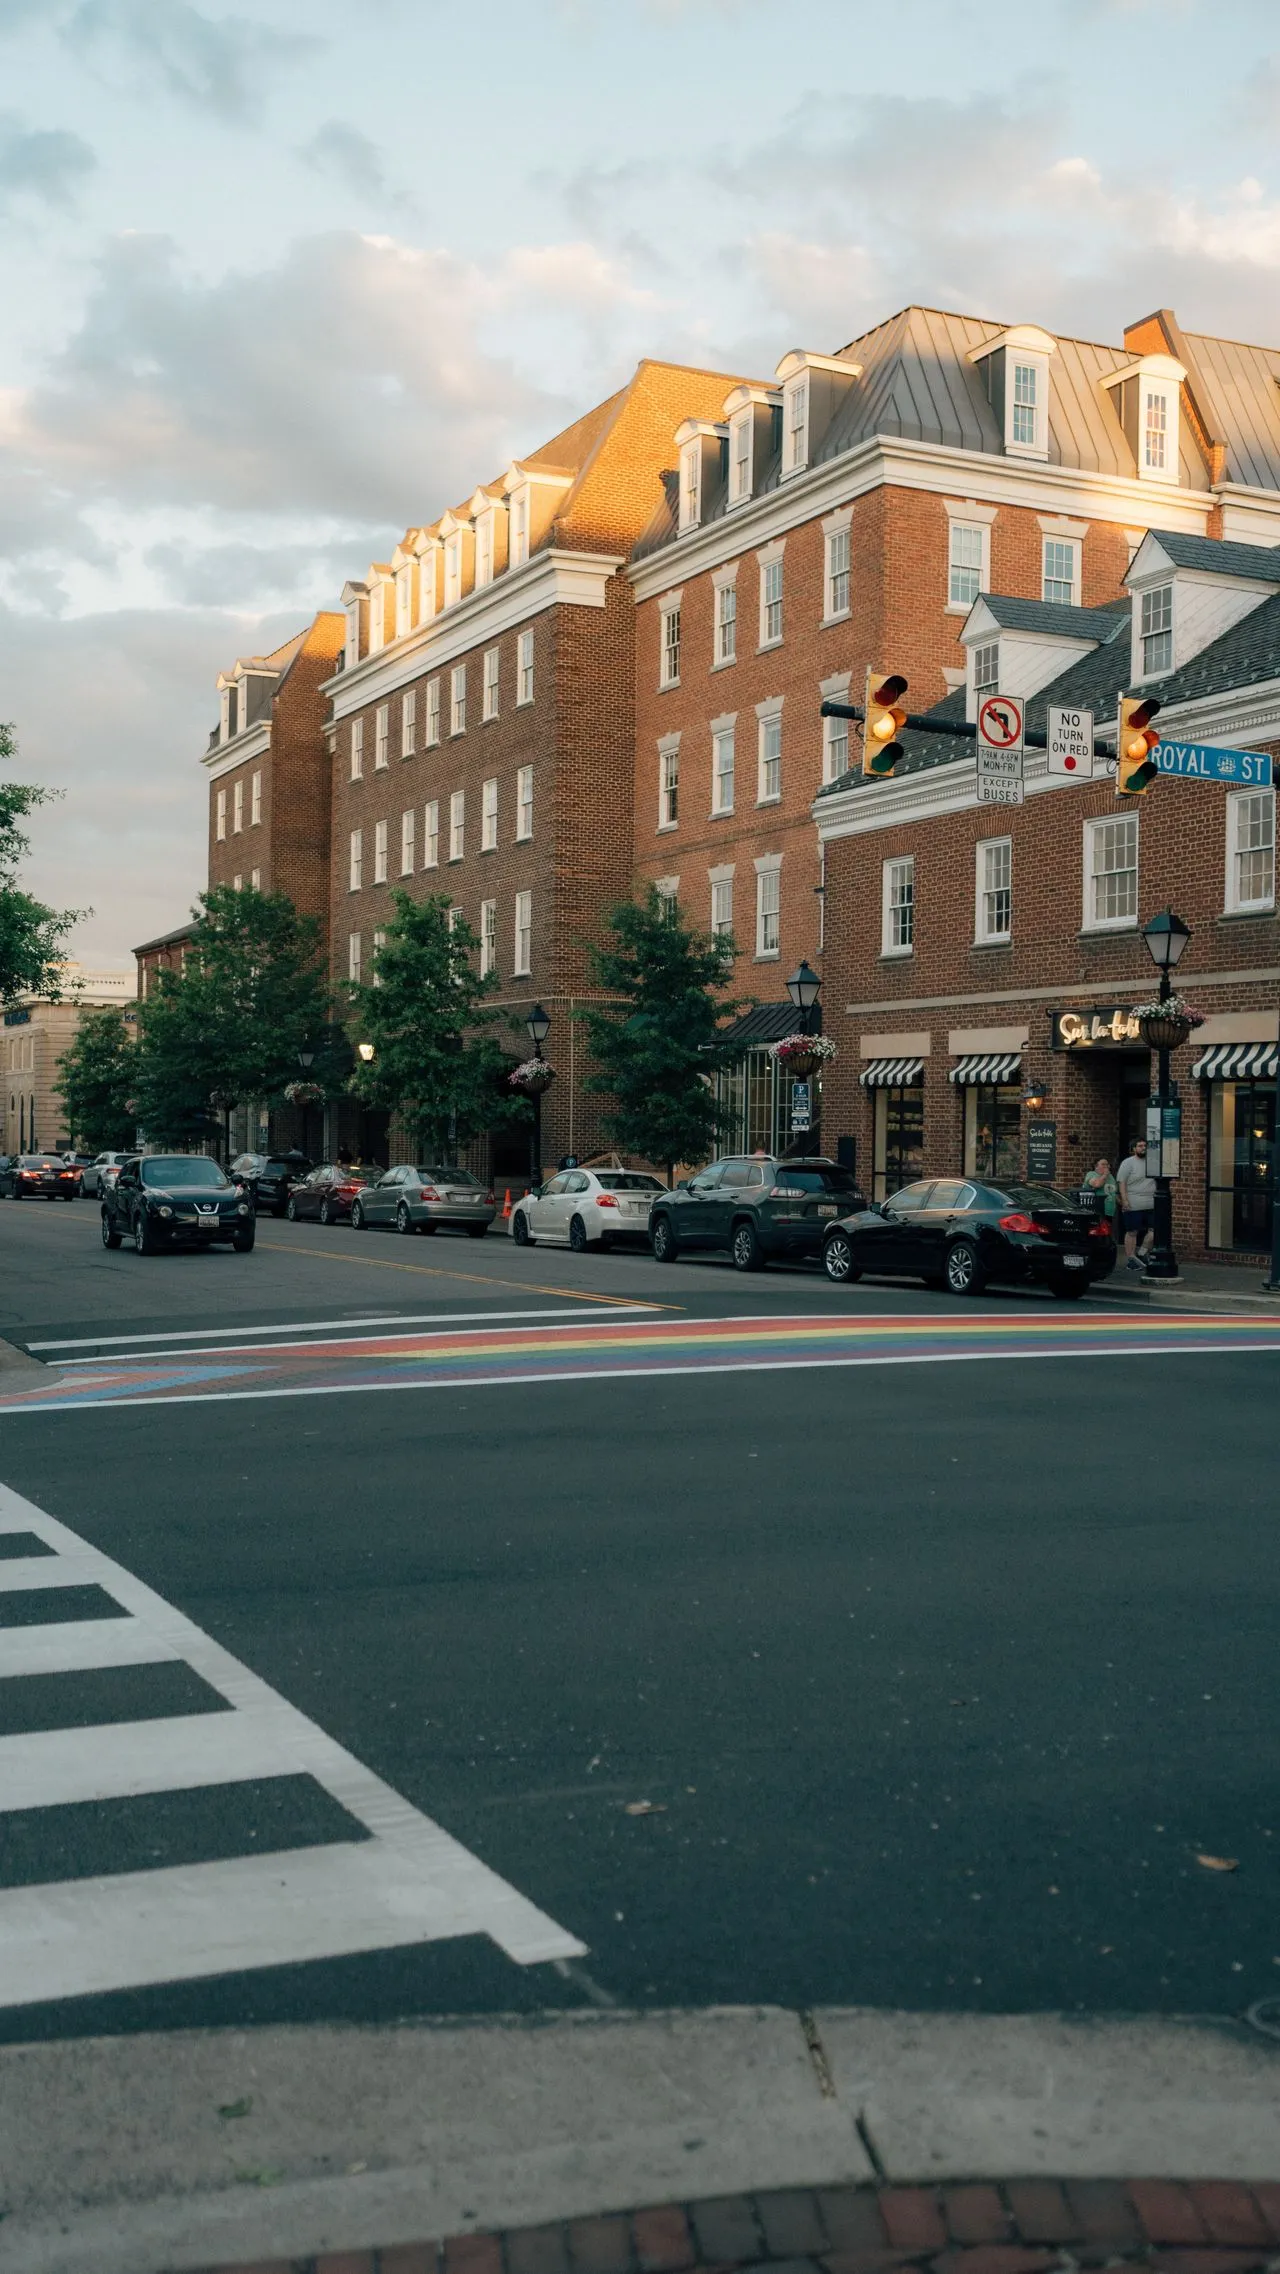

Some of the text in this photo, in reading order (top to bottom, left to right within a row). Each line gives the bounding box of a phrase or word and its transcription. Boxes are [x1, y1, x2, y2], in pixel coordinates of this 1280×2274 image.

[1061, 713, 1081, 727] NO
[1057, 728, 1084, 742] TURN
[1052, 742, 1089, 756] ON RED
[980, 750, 1019, 762] 7-9AM 4-6PM
[1150, 744, 1265, 781] ROYAL ST
[983, 760, 1015, 772] MON-FRI
[983, 777, 1019, 788] EXCEPT
[983, 789, 1019, 802] BUSES
